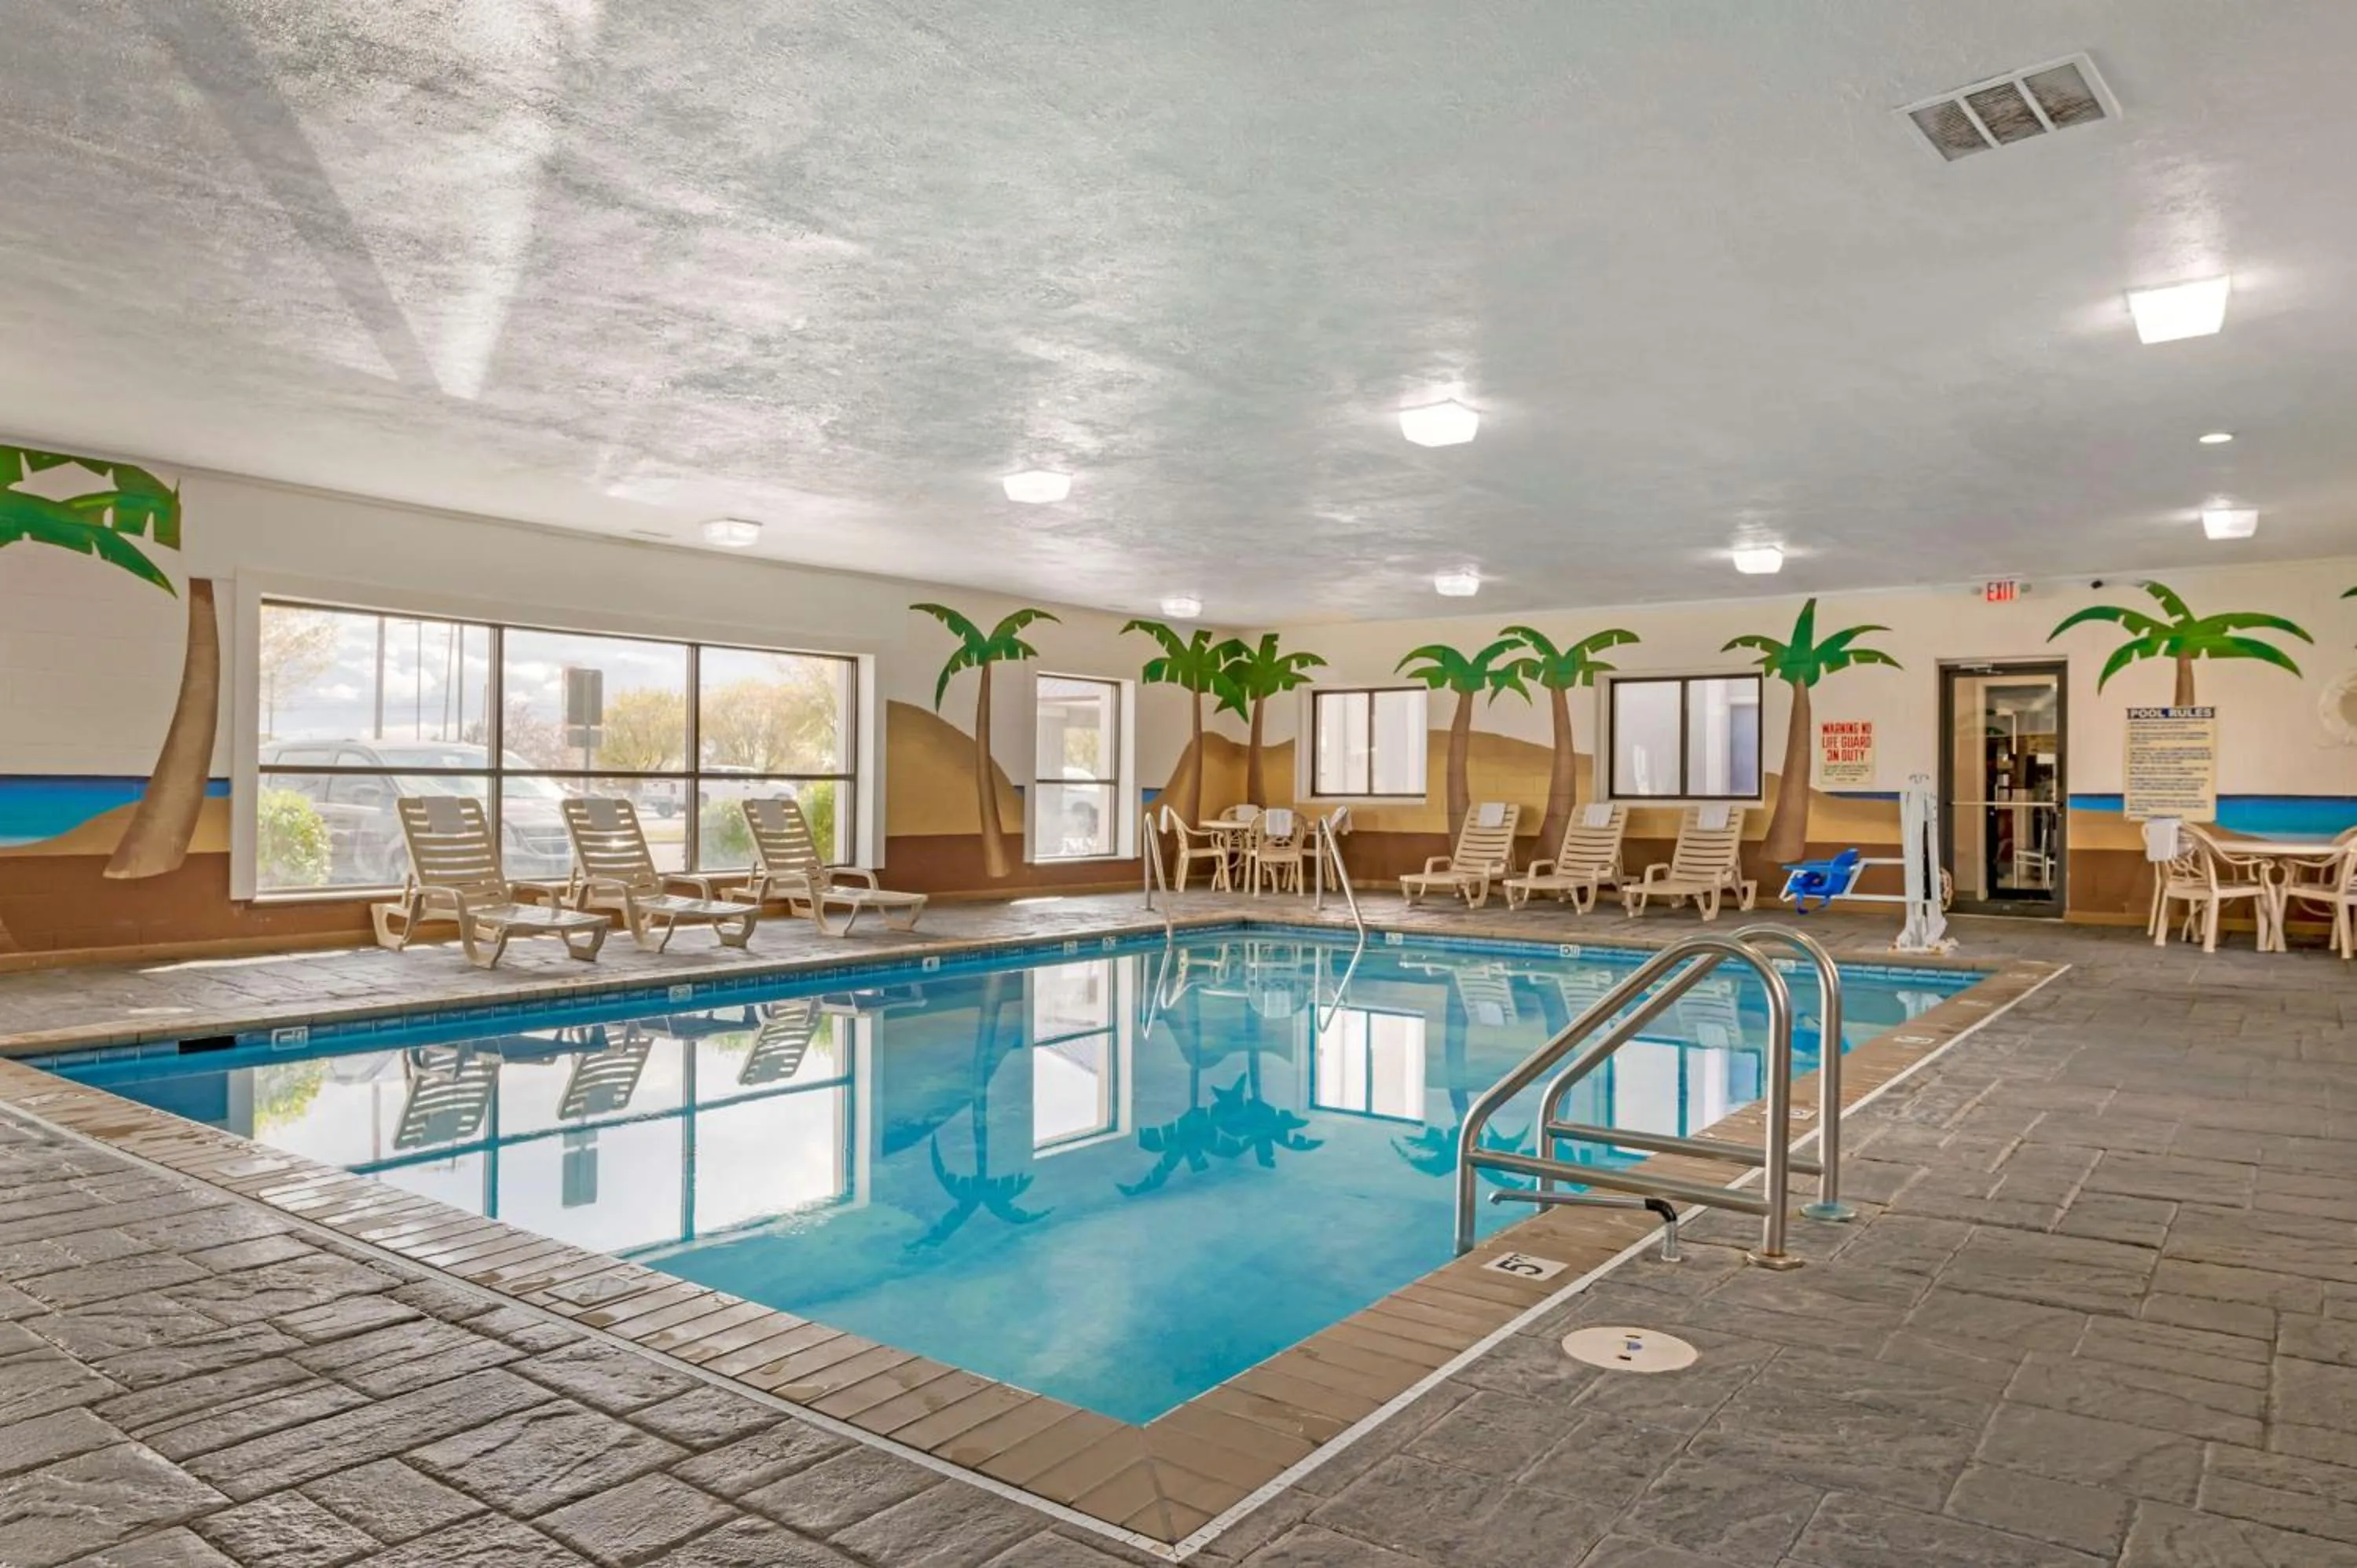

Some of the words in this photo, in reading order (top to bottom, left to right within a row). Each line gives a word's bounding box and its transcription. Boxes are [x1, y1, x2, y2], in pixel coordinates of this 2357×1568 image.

[1987, 581, 2014, 601] EXIT
[2130, 709, 2166, 717] POOL
[2169, 708, 2212, 717] RULES
[1822, 736, 1838, 749] LIFE
[1841, 735, 1871, 749] GUARD
[1841, 749, 1864, 761] DUTY
